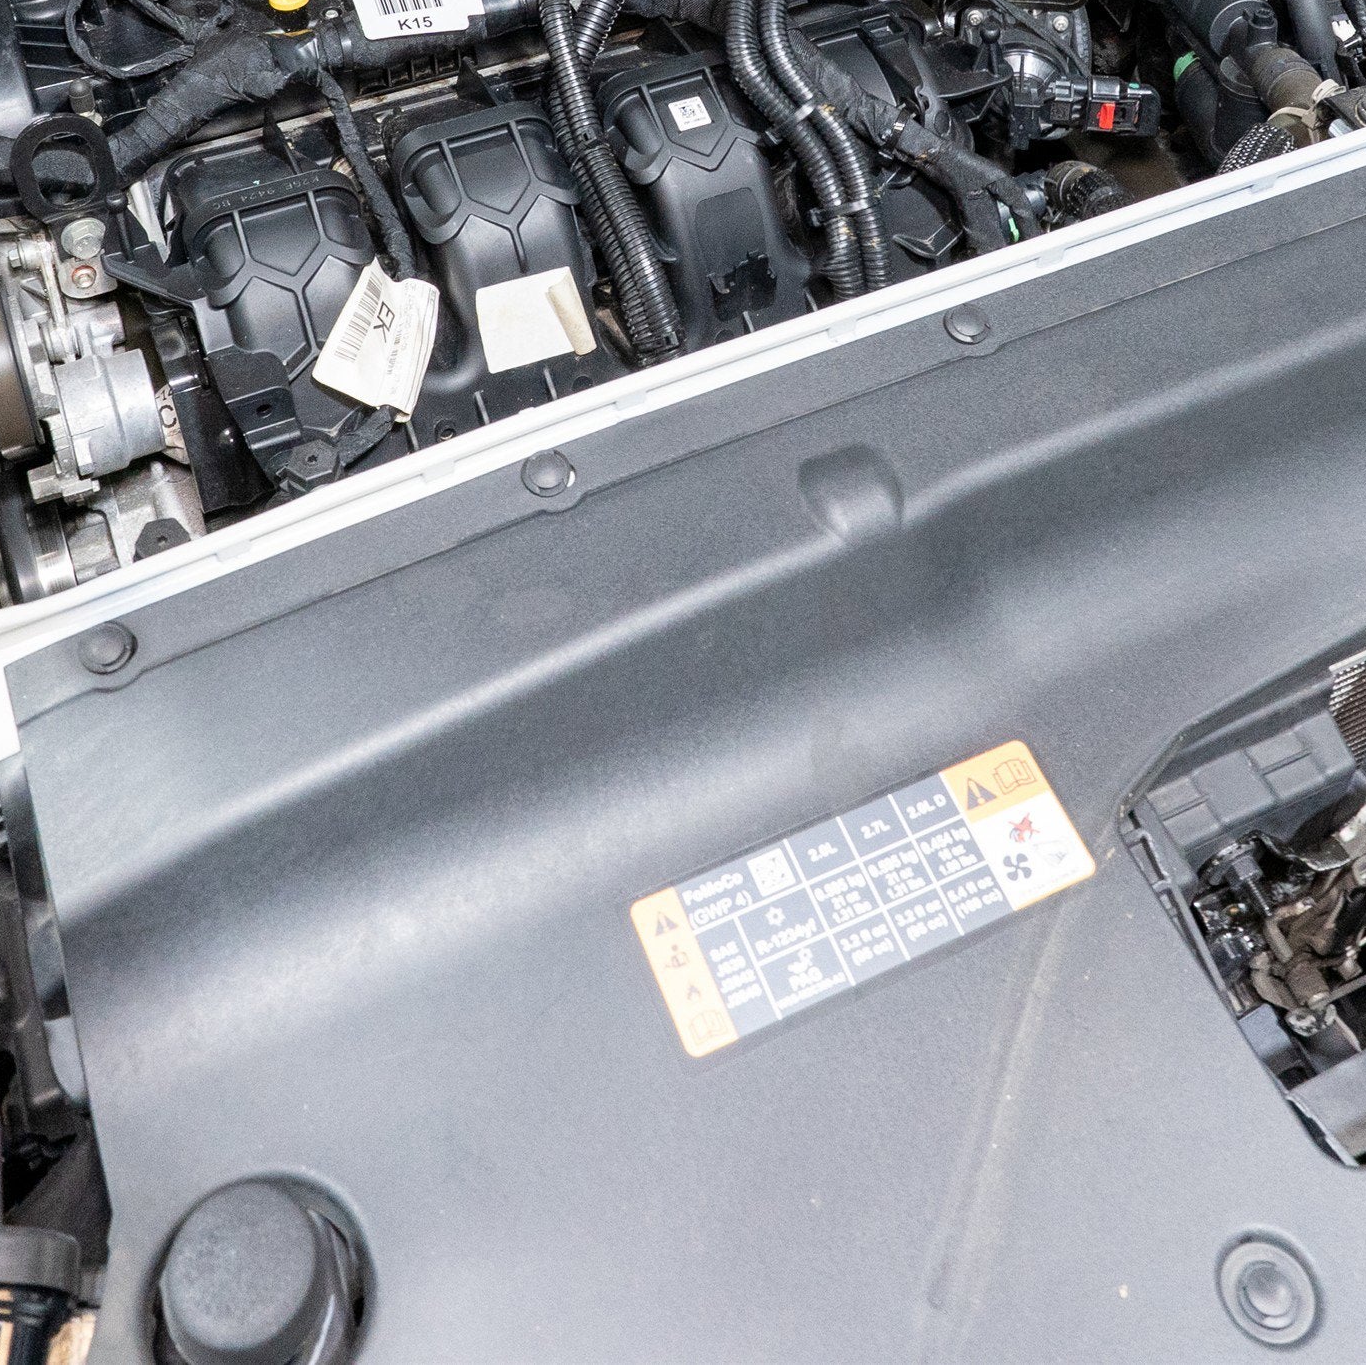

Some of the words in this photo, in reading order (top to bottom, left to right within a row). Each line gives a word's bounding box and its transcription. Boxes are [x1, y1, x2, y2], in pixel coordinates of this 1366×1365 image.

[398, 16, 433, 30] K15
[933, 794, 947, 807] D
[861, 820, 890, 839] 2.7L
[682, 873, 743, 906] FoMoCo
[689, 897, 732, 928] (GWP
[735, 890, 752, 906] 4)
